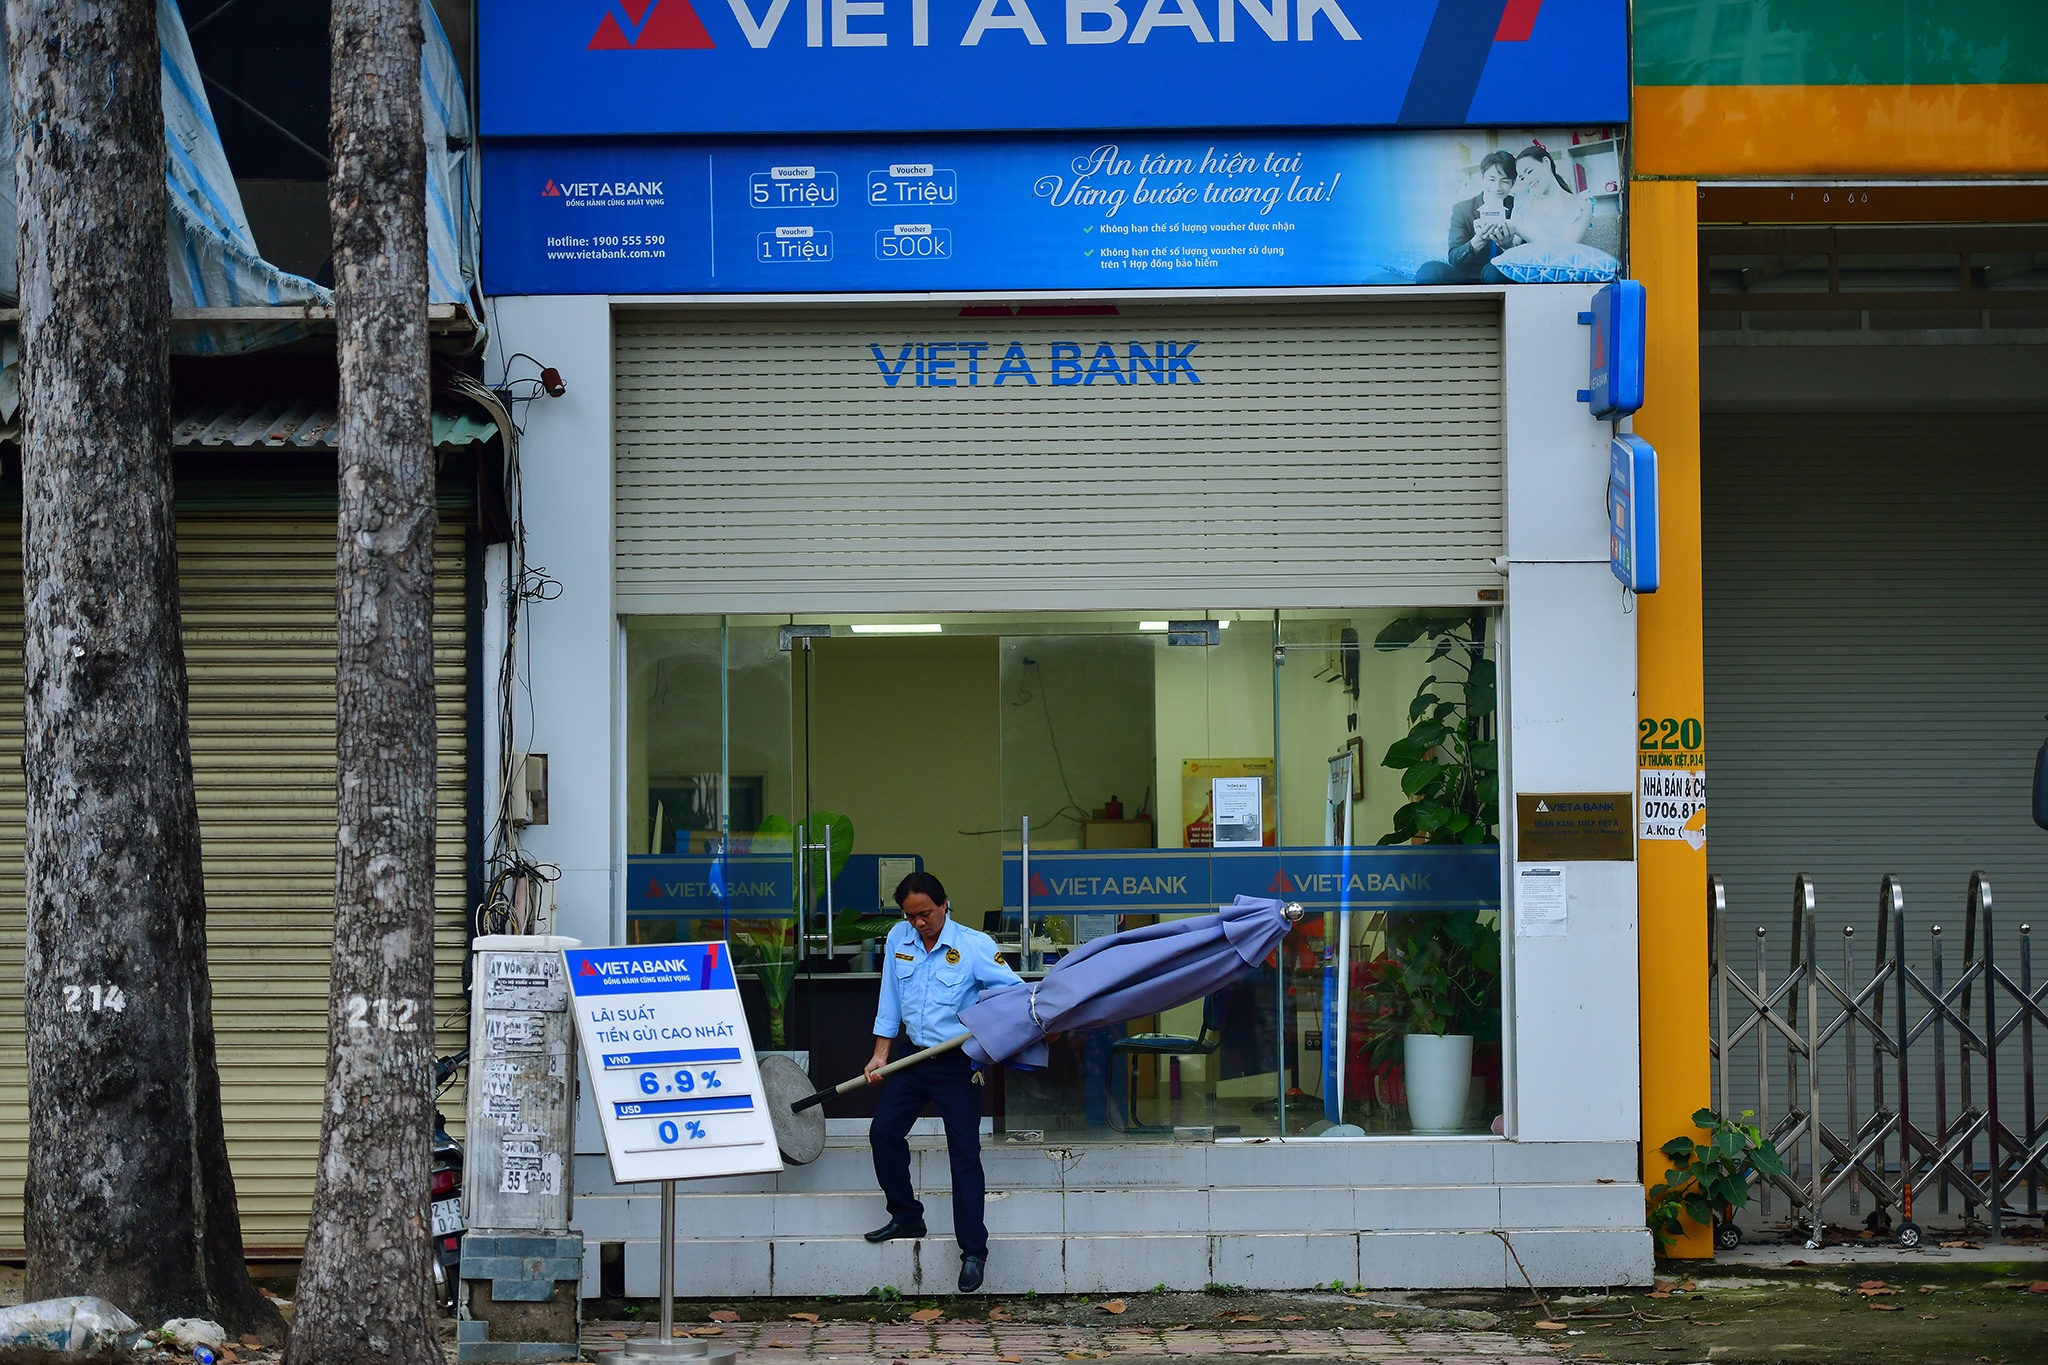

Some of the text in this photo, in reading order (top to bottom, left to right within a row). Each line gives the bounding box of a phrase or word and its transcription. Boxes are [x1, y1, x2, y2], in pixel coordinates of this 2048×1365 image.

[1071, 144, 1304, 178] An tâm hiện tại
[778, 168, 809, 177] Voucher
[896, 166, 927, 174] Voucher
[753, 182, 834, 206] 5 Triệu
[871, 181, 953, 205] 2 Triệu
[1033, 172, 1342, 218] Vững bước tương lai!
[565, 197, 665, 207] ĐỒNG HÀNH CÙNG KHÁT VỌNG
[1100, 221, 1295, 235] Không hạn chế số lượng voucher được nhận
[547, 235, 665, 247] Hotline: 1900 555 590
[882, 236, 946, 256] 500k
[547, 248, 666, 259] www.vietabank.com.vn
[763, 241, 828, 261] 1 Triệu
[1100, 244, 1285, 258] Không hạn chế số lượng voucher sử dụng
[1100, 256, 1218, 270] trên 1 Hợp đồng bảo hiểm
[1639, 718, 1702, 750] 220
[1643, 772, 1662, 797] NHÀ
[1664, 771, 1683, 797] BÁN
[1685, 777, 1692, 797] &
[1646, 825, 1675, 836] A.Kha
[603, 974, 690, 985] ĐỒNG HÀNH CÙNG KHÁT VỌNG
[62, 984, 126, 1013] 214
[348, 996, 418, 1032] 212
[591, 1003, 655, 1023] LÃI SUẤT
[596, 1021, 734, 1043] TIỀN GỬI CAO NHẤT
[609, 1055, 631, 1065] VND
[620, 1105, 641, 1115] USD
